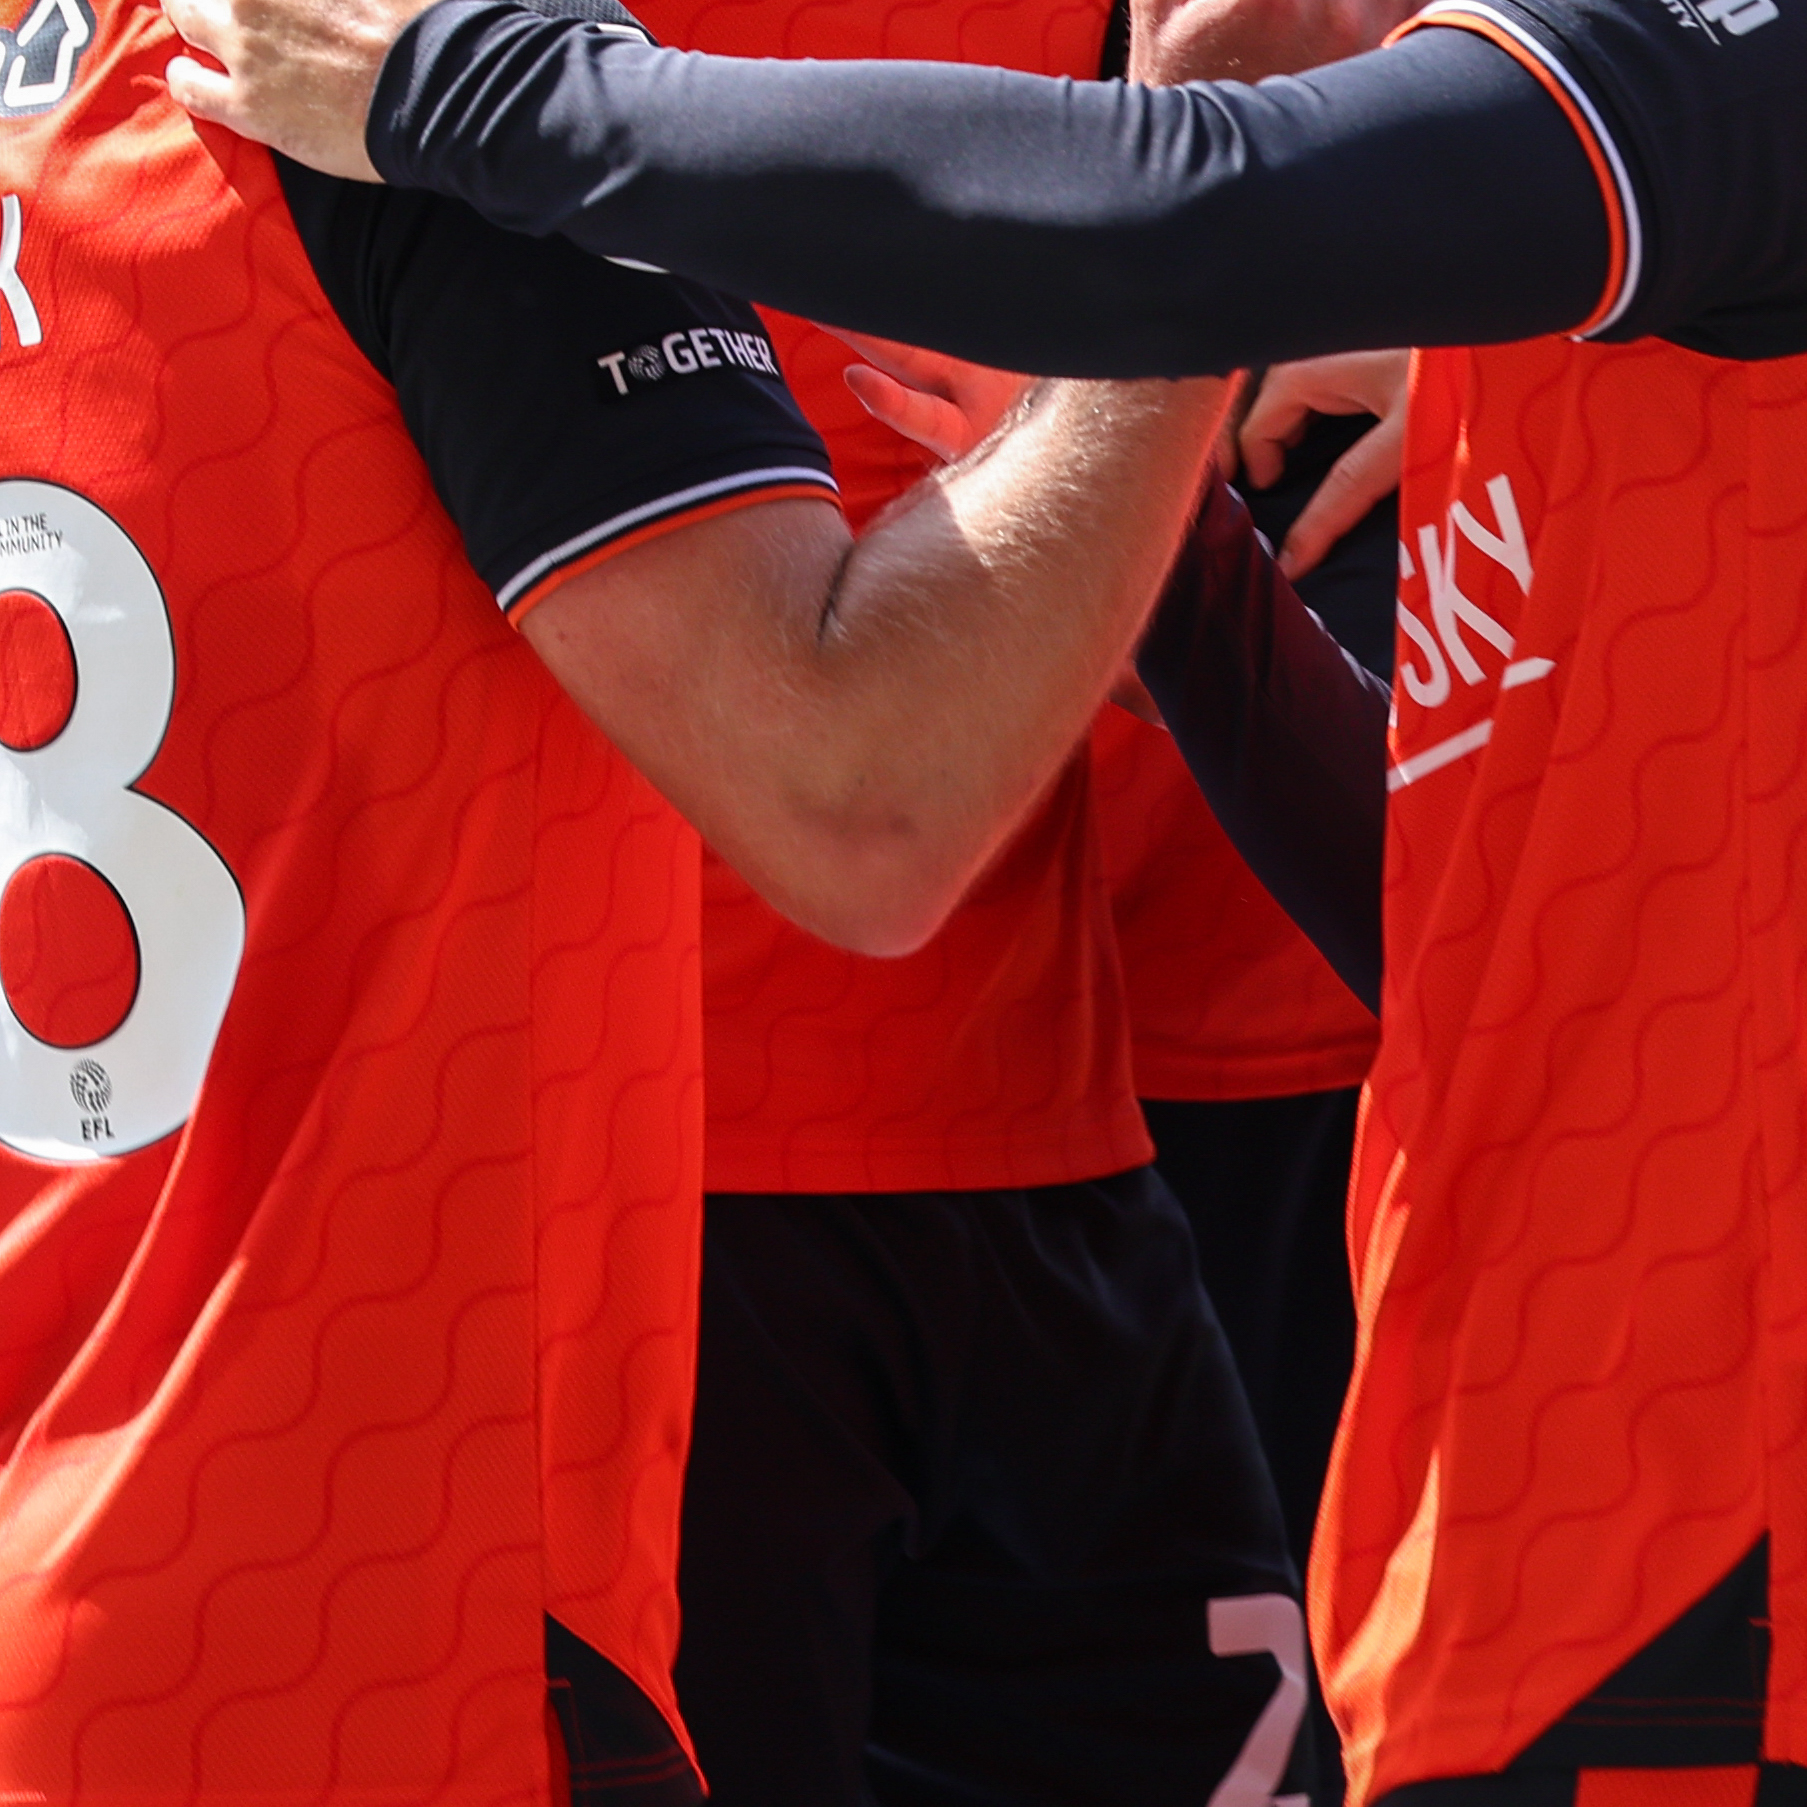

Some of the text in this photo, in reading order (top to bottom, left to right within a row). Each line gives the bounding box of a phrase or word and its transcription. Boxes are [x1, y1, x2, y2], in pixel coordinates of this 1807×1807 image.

[5, 517, 20, 536] IN
[22, 512, 48, 532] THE
[80, 1115, 116, 1142] EFL
